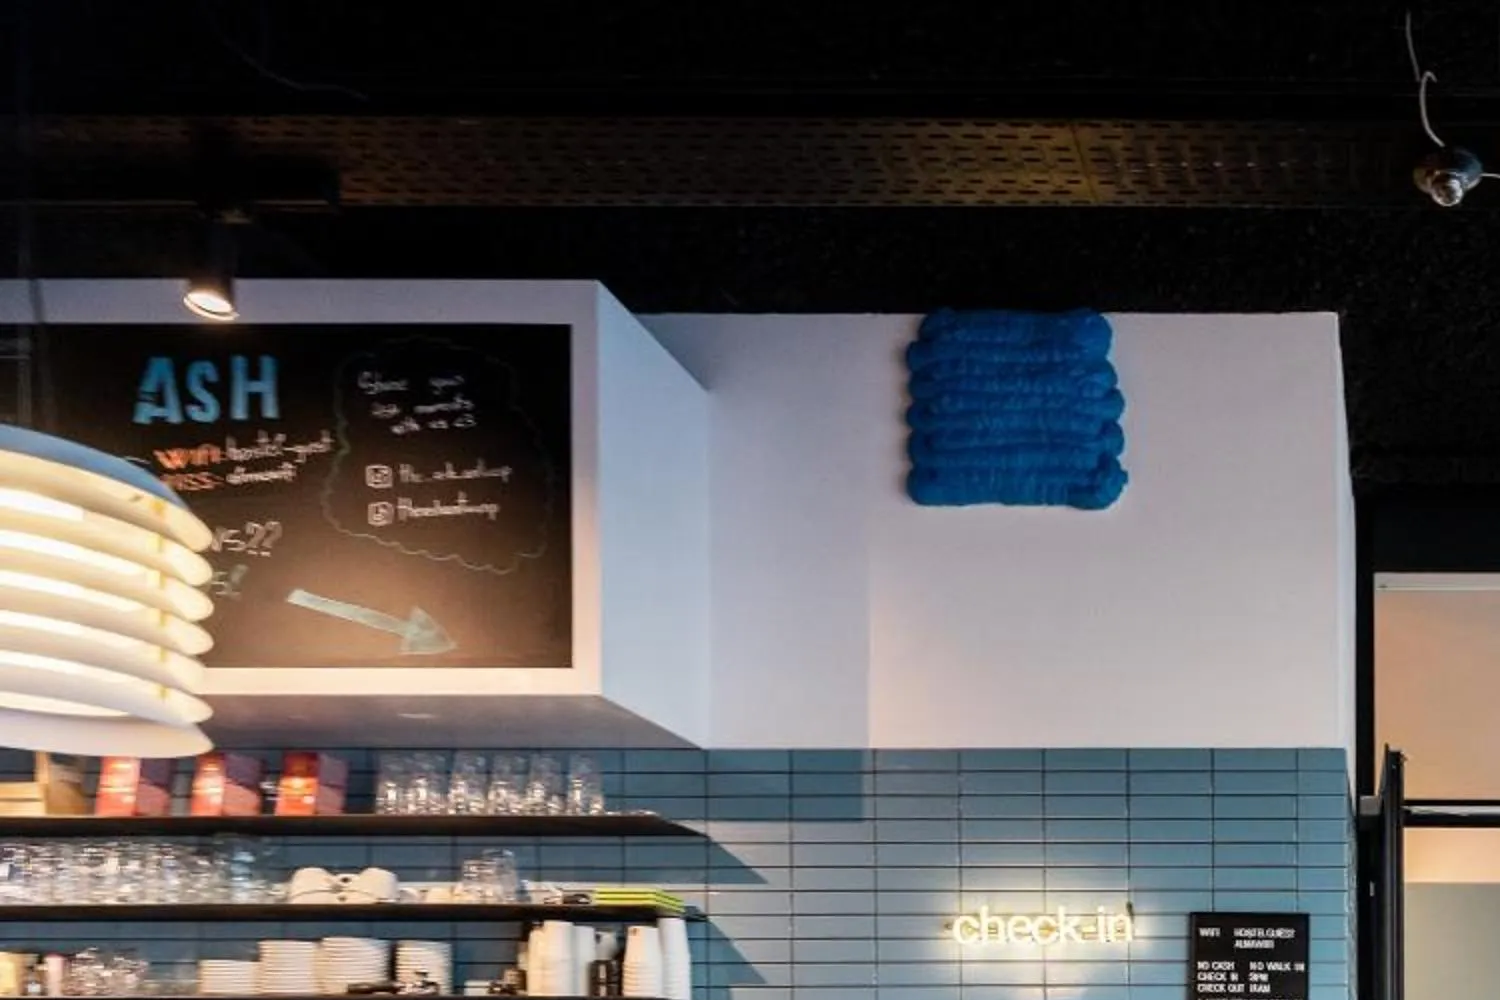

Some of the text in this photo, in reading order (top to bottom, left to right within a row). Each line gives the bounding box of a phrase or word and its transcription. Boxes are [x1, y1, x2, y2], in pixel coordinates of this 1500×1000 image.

[133, 355, 281, 425] ASH
[952, 904, 1133, 945] check-in
[1197, 961, 1210, 971] NO
[1211, 961, 1235, 971] CASH
[1249, 961, 1265, 971] NO
[1266, 961, 1292, 971] WALK
[1197, 972, 1227, 982] CHECK
[1230, 972, 1239, 982] IN
[1197, 983, 1227, 993] CHECK
[1227, 983, 1245, 993] OUT
